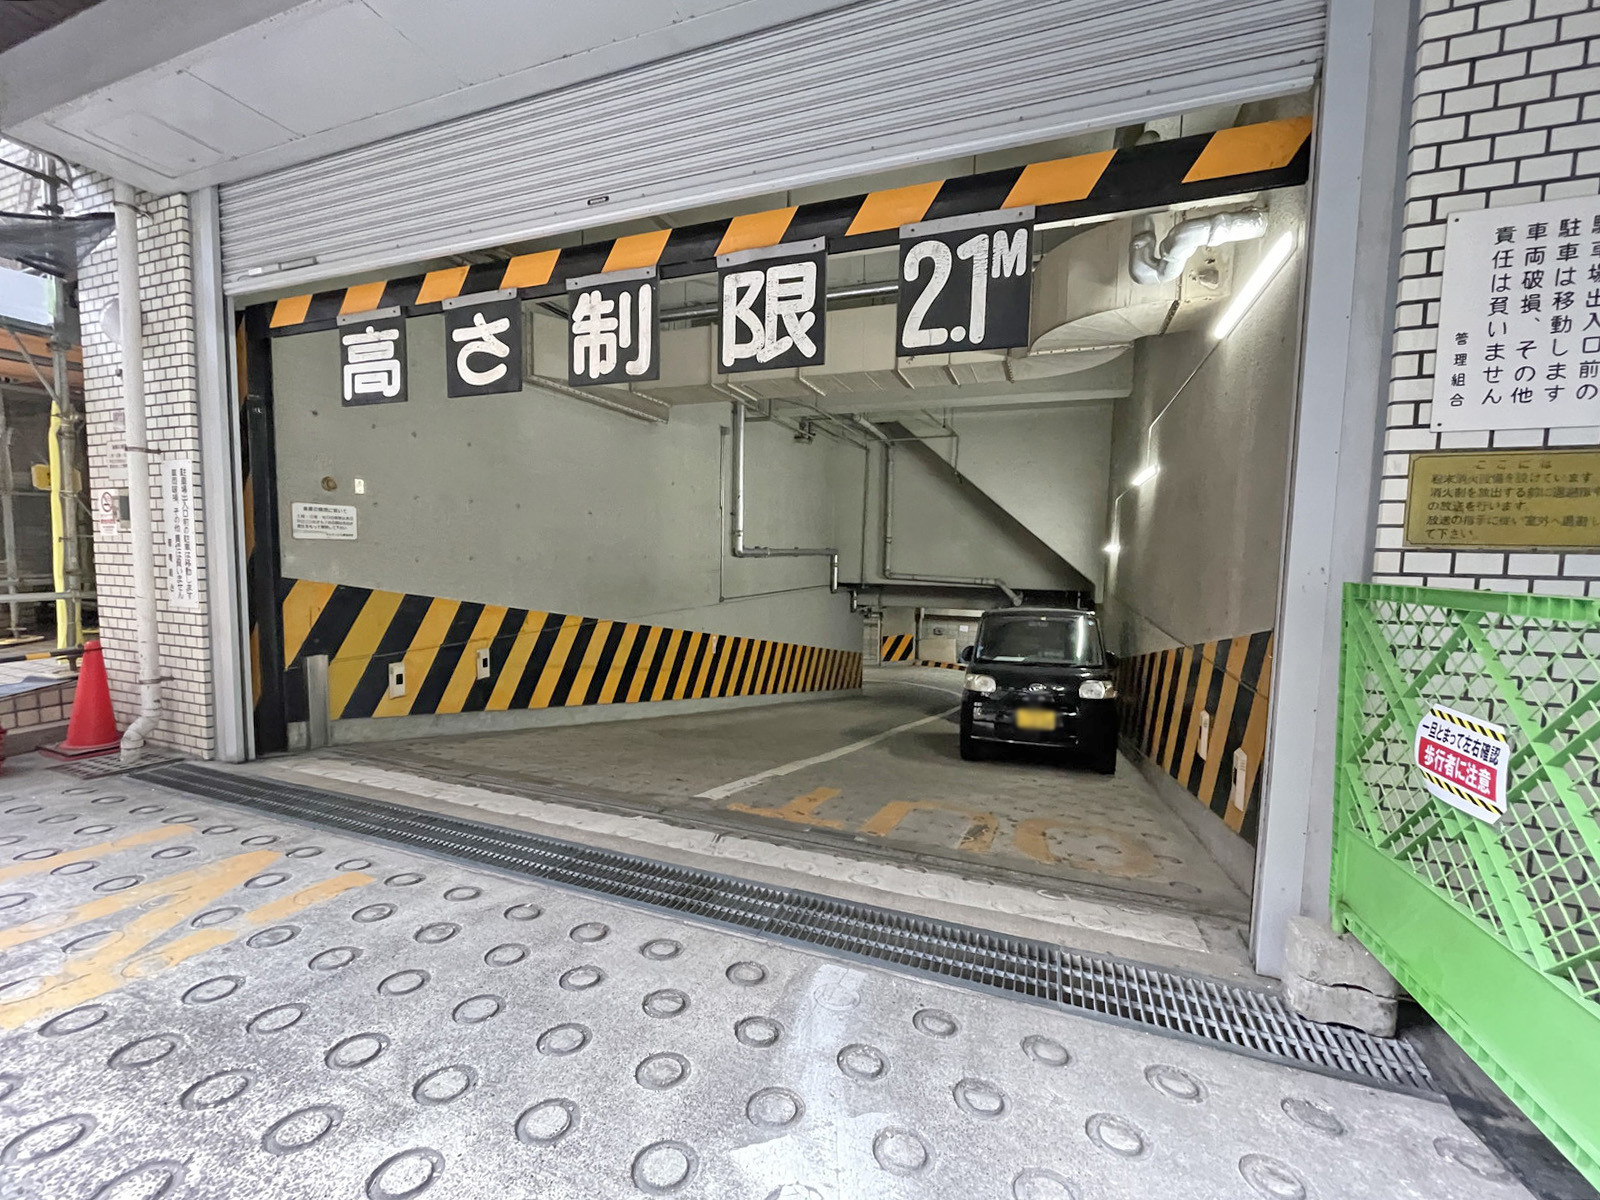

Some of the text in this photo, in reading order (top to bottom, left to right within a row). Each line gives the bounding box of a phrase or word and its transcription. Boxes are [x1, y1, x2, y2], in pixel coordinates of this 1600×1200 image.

[901, 229, 1028, 349] 2.1M
[1481, 226, 1518, 406] 責任は負いません
[1510, 222, 1548, 405] 車両破損、その他
[1544, 218, 1582, 403] 駐車は移動します
[1449, 332, 1470, 408] 管理組合
[1422, 721, 1501, 766] 一旦とまって左右確認
[1424, 744, 1492, 795] 歩行者に注意
